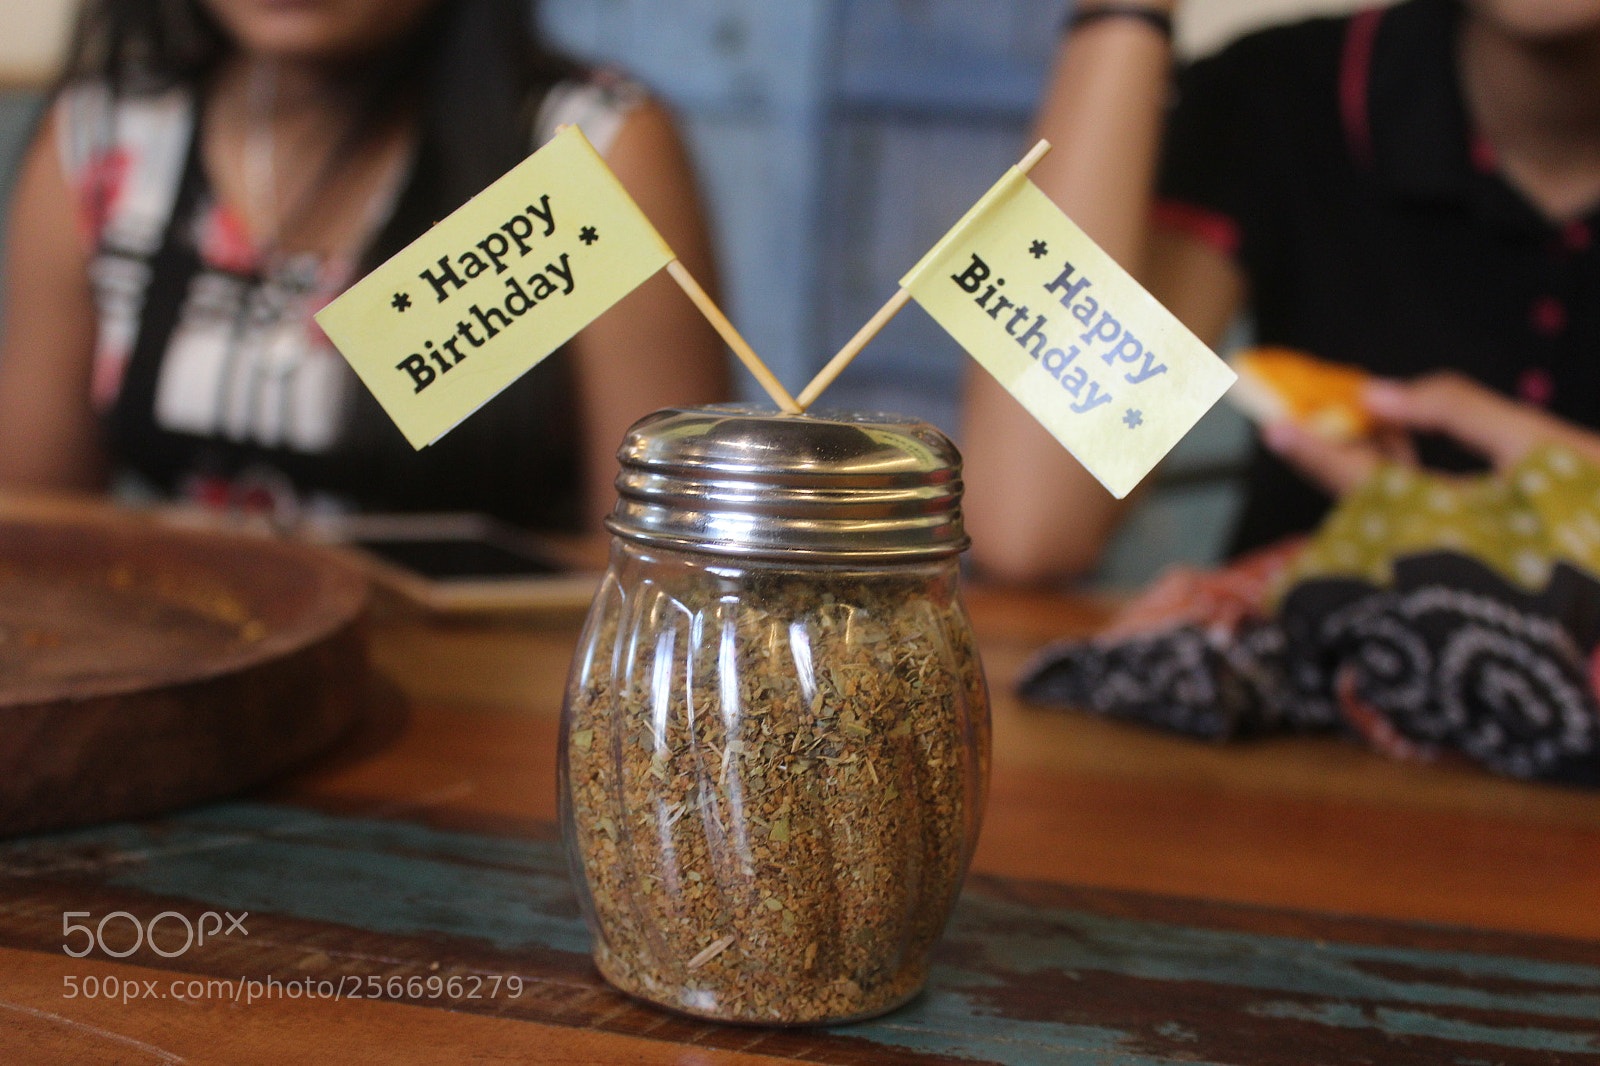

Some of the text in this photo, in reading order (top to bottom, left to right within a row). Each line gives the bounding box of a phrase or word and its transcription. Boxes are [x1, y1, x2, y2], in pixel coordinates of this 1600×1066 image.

[419, 194, 556, 303] Happy
[395, 252, 575, 395] Birthday
[950, 253, 1113, 414] Birthday
[1043, 261, 1168, 385] Happy
